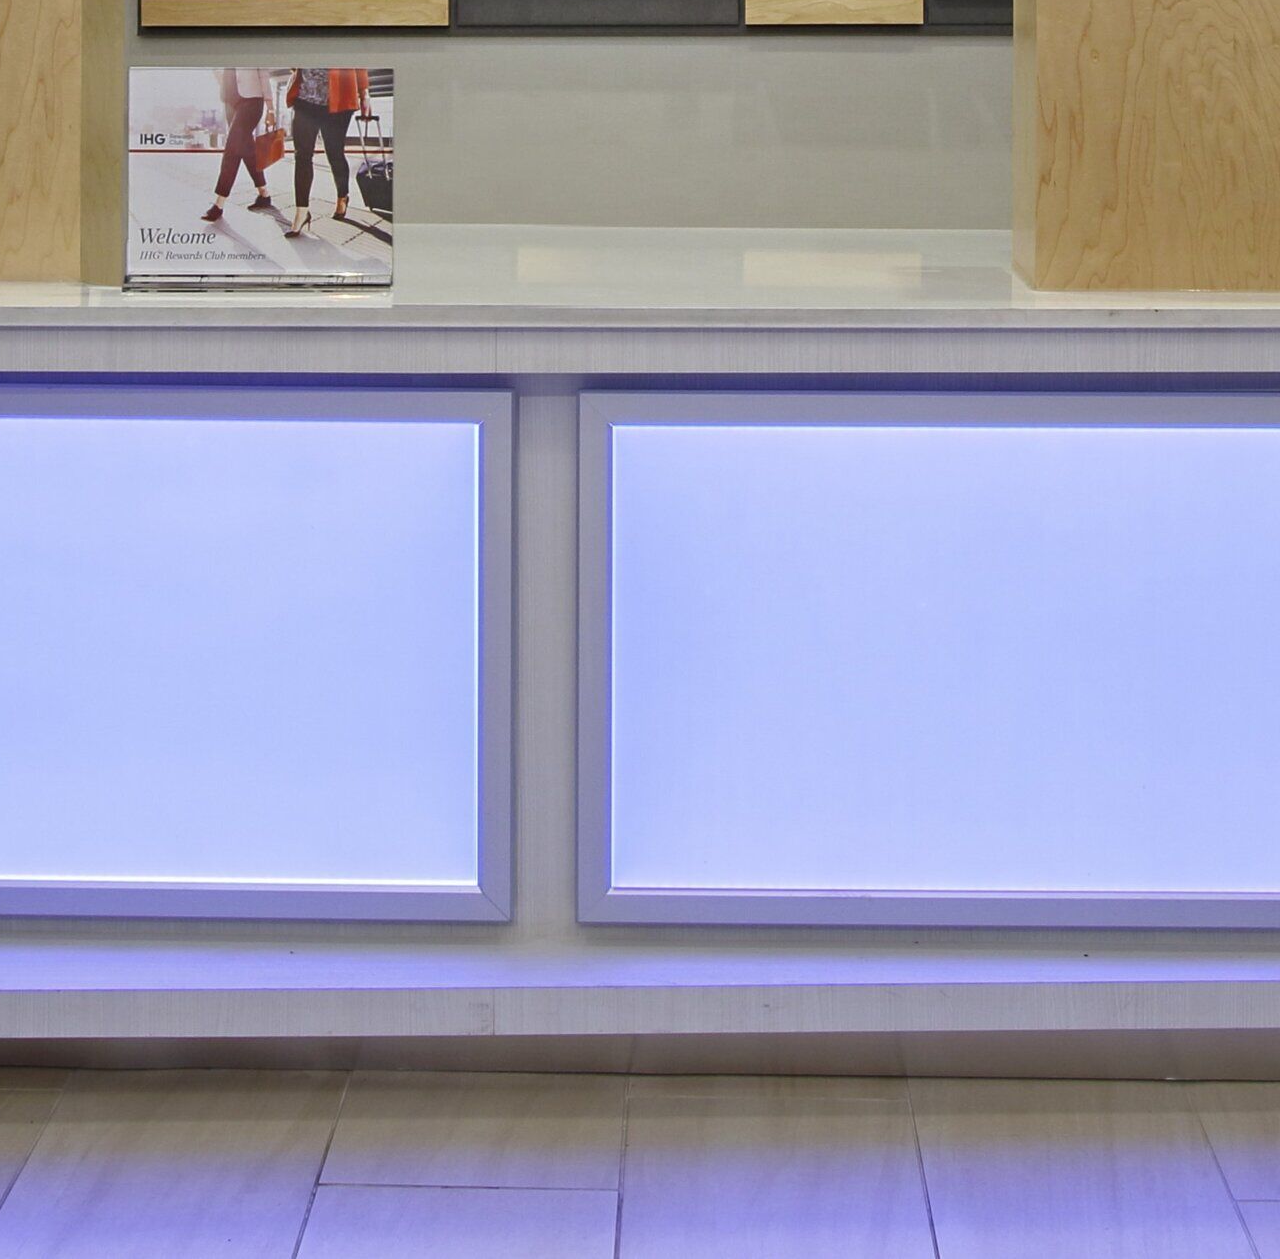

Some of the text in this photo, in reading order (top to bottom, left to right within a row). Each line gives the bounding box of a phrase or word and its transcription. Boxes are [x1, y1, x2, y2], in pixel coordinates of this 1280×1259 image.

[140, 133, 166, 145] IHG
[140, 228, 216, 245] Welcome
[165, 251, 202, 261] Rewards
[204, 251, 226, 261] Club
[227, 251, 266, 261] members
